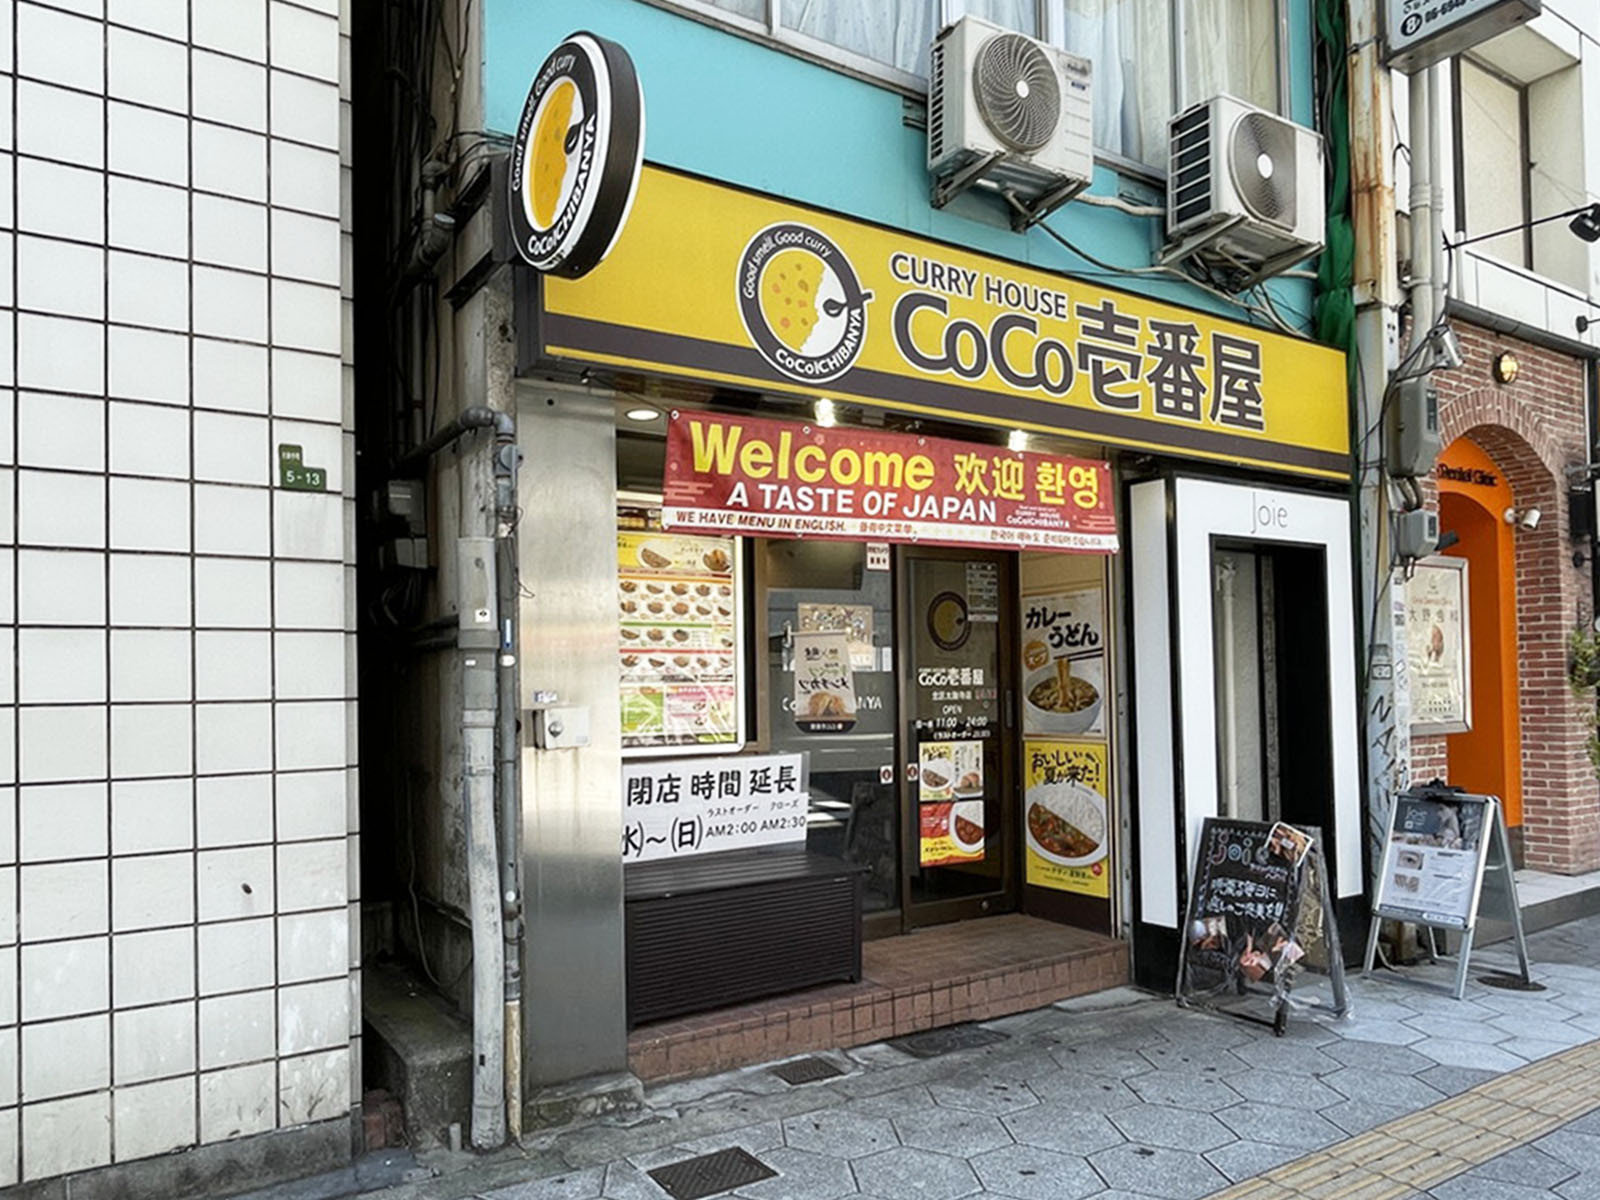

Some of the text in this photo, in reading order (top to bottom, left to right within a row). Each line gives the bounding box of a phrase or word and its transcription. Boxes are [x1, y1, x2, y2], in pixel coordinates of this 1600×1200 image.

[743, 261, 758, 298] Good
[774, 231, 804, 245] Good
[805, 236, 832, 257] curry
[890, 252, 1067, 319] CURRY HOUSE
[689, 421, 935, 491] Welcome
[953, 452, 1026, 501] 欢迎
[726, 482, 996, 524] A TASTE OF JAPAN
[1035, 462, 1098, 509] 환영
[676, 511, 695, 523] WE
[699, 512, 733, 526] HAVE
[737, 514, 775, 529] MENU
[778, 517, 792, 529] IN
[795, 518, 846, 533] ENGLISH.
[1250, 492, 1288, 534] Joie
[1026, 606, 1072, 629] カレー
[1048, 622, 1099, 648] うどん
[627, 766, 797, 807] 閉店 時間 延長
[705, 821, 757, 838] AM2:00
[760, 815, 807, 832] AM2:30
[707, 804, 759, 818] ラストオーダー
